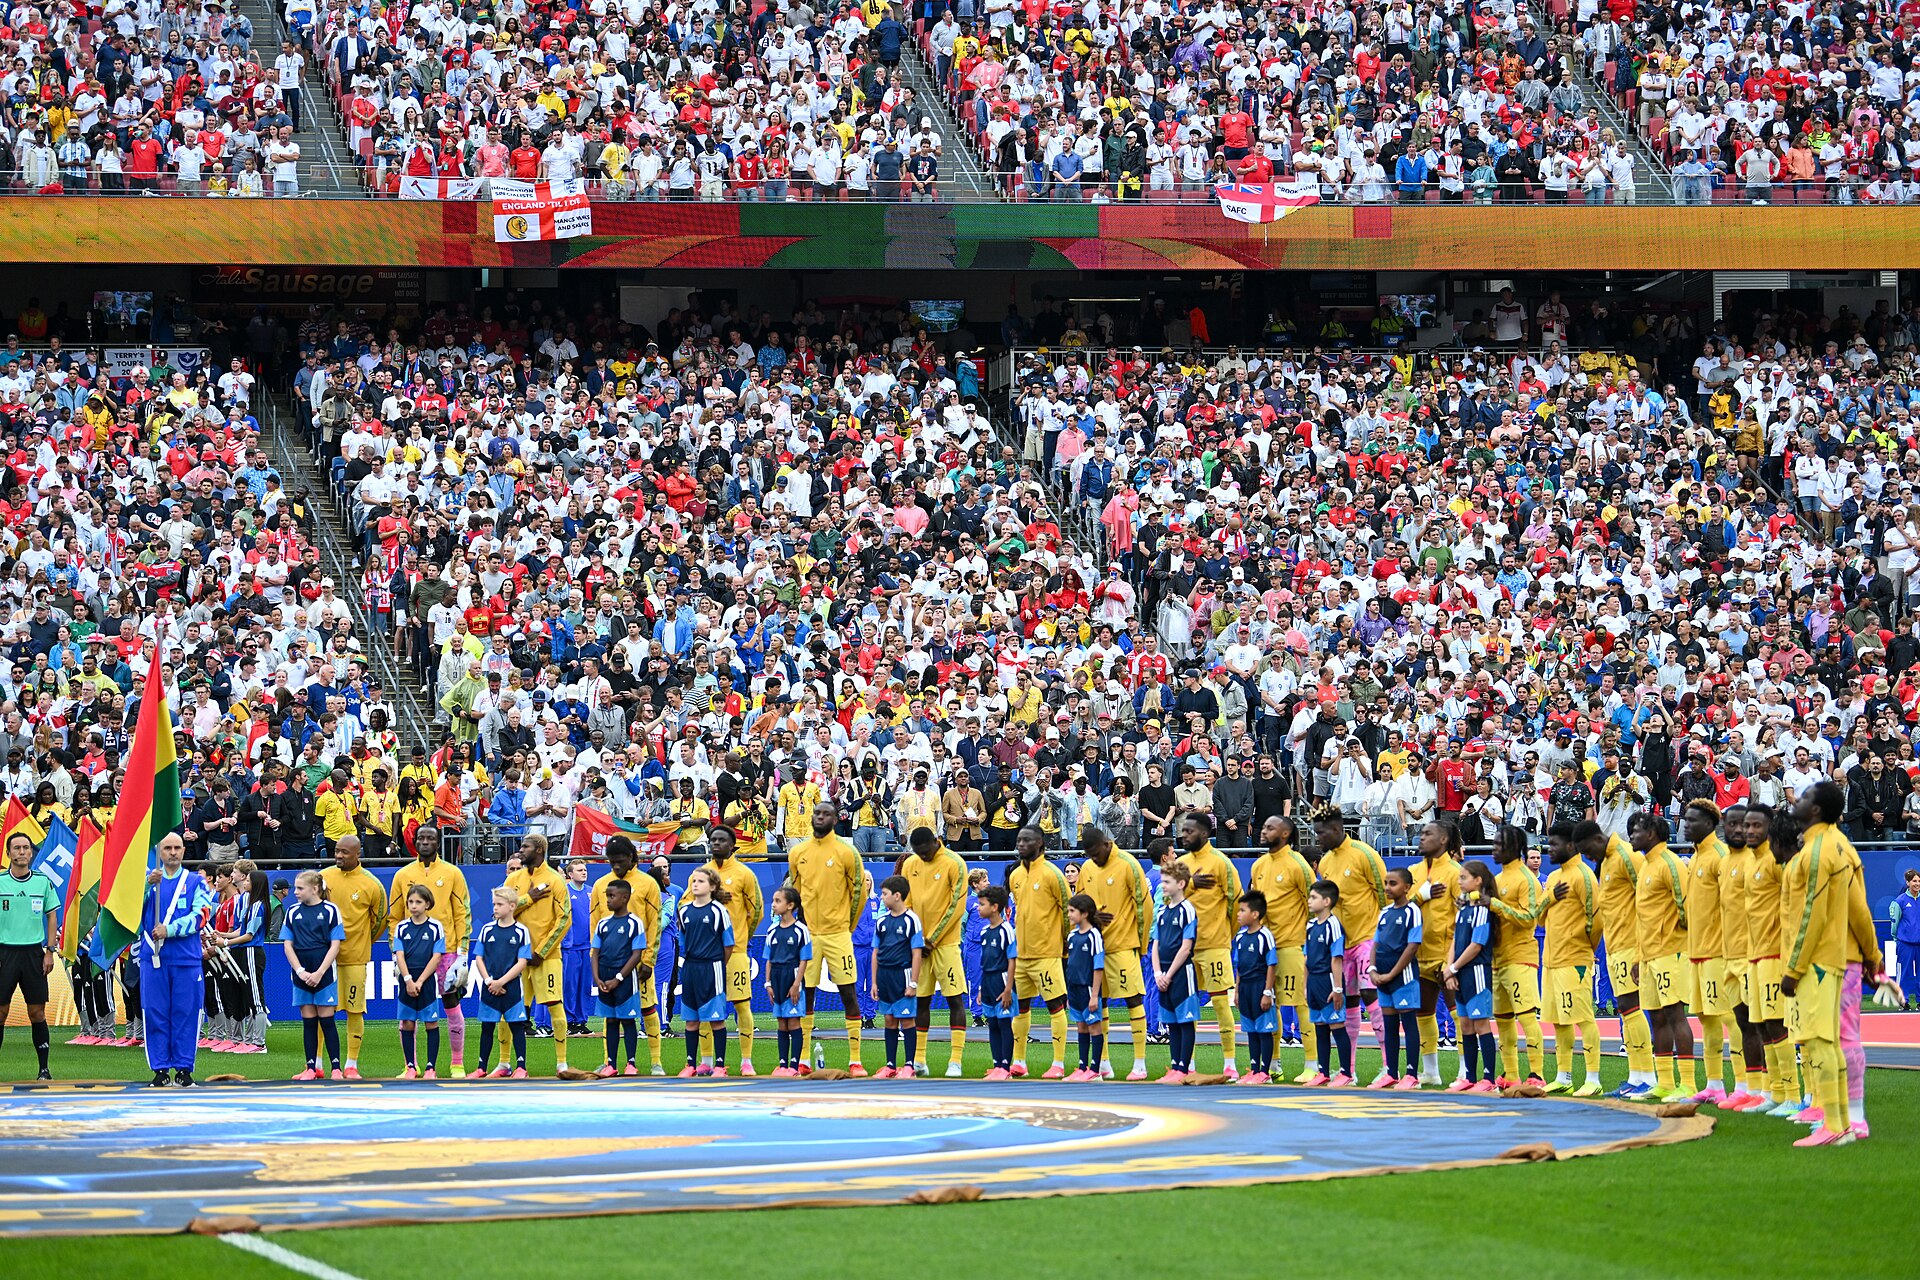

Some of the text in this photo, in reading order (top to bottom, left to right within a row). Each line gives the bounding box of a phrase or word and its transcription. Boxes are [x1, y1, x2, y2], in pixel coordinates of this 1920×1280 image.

[502, 202, 545, 210] ENGLAND
[1226, 204, 1247, 215] SAFC
[243, 268, 374, 299] Sausage
[814, 751, 822, 759] 10
[842, 955, 854, 971] 18
[1209, 961, 1224, 977] 19
[548, 973, 554, 988] 8
[733, 971, 747, 986] 26
[947, 967, 955, 982] 4
[1040, 971, 1052, 987] 14
[1119, 969, 1127, 984] 5
[1656, 972, 1671, 989] 25
[1284, 975, 1296, 991] 11
[1512, 982, 1520, 998] 2
[1706, 981, 1718, 998] 21
[349, 985, 357, 999] 9
[1561, 991, 1573, 1008] 13
[1765, 984, 1780, 1001] 17
